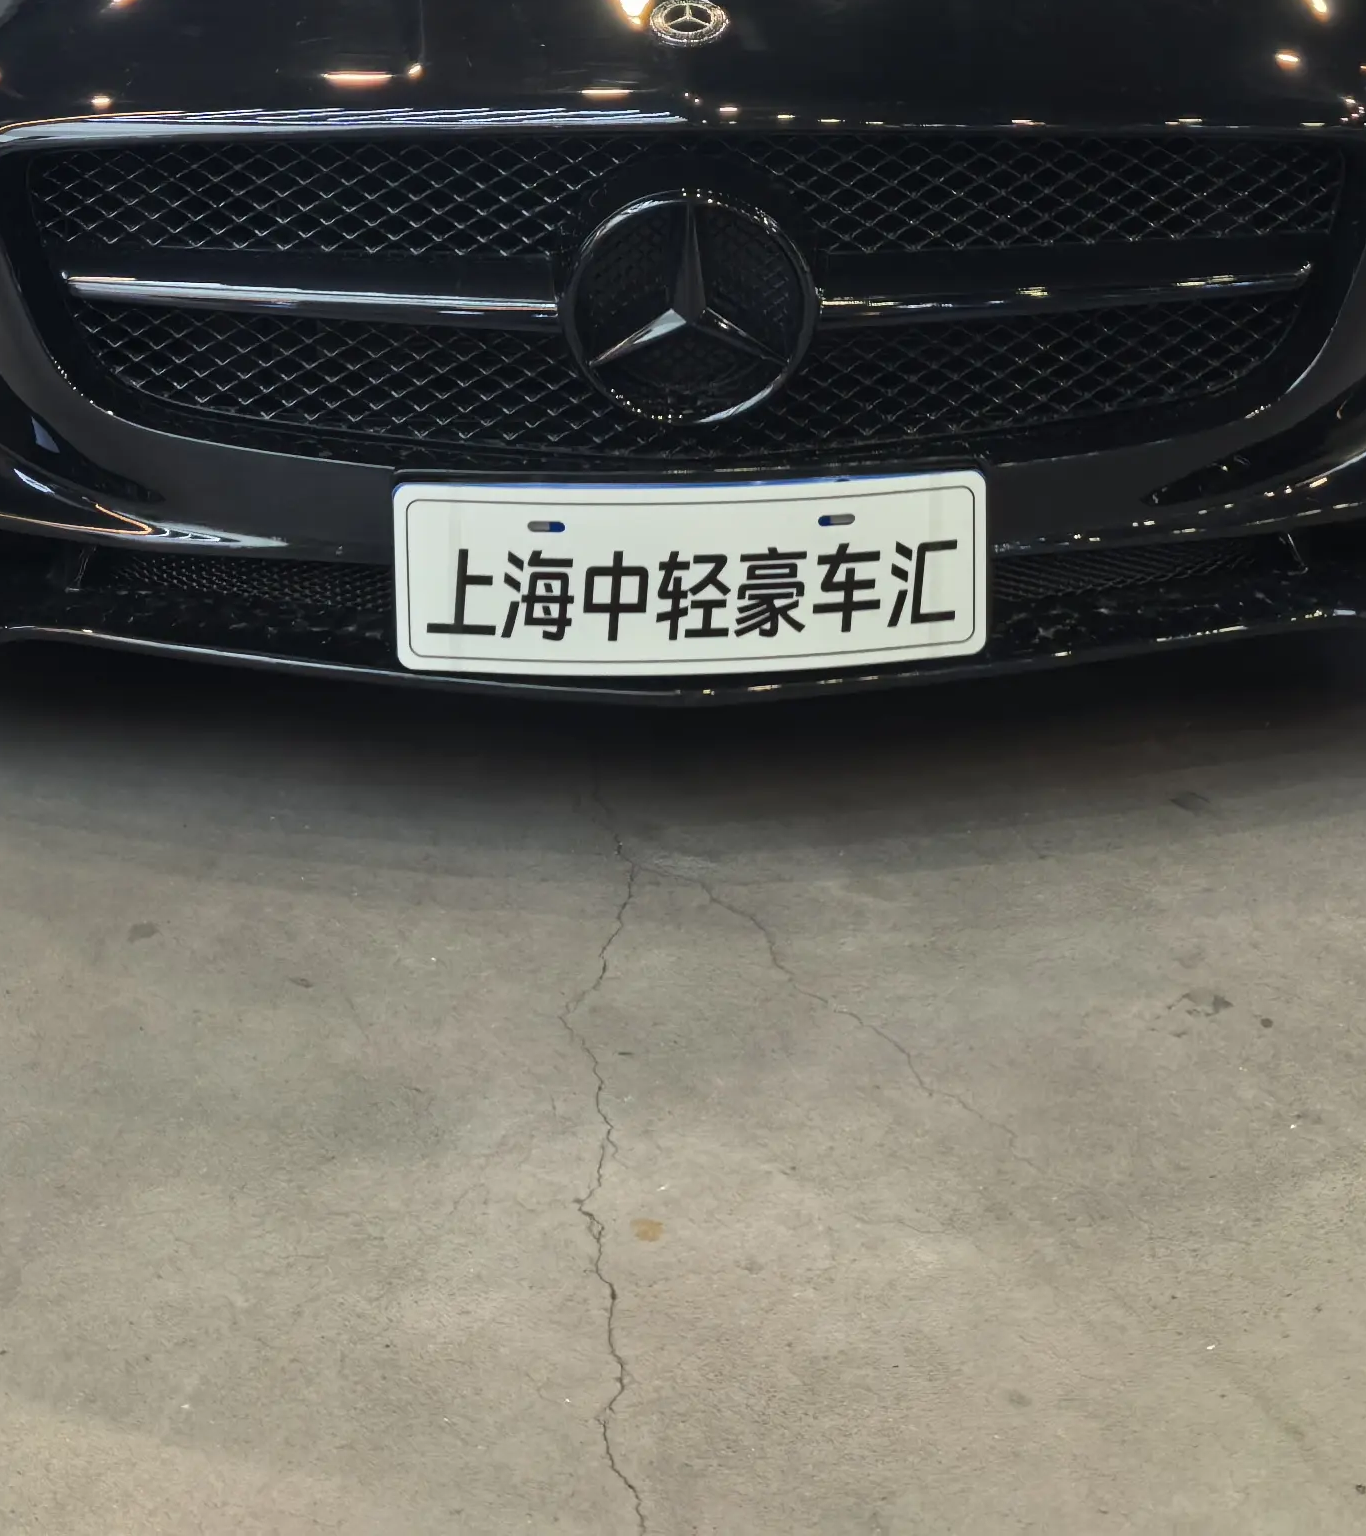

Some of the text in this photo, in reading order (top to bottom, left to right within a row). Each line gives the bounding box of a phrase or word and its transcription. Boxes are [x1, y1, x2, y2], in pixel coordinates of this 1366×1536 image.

[426, 538, 959, 642] 上海中轻豪车汇
